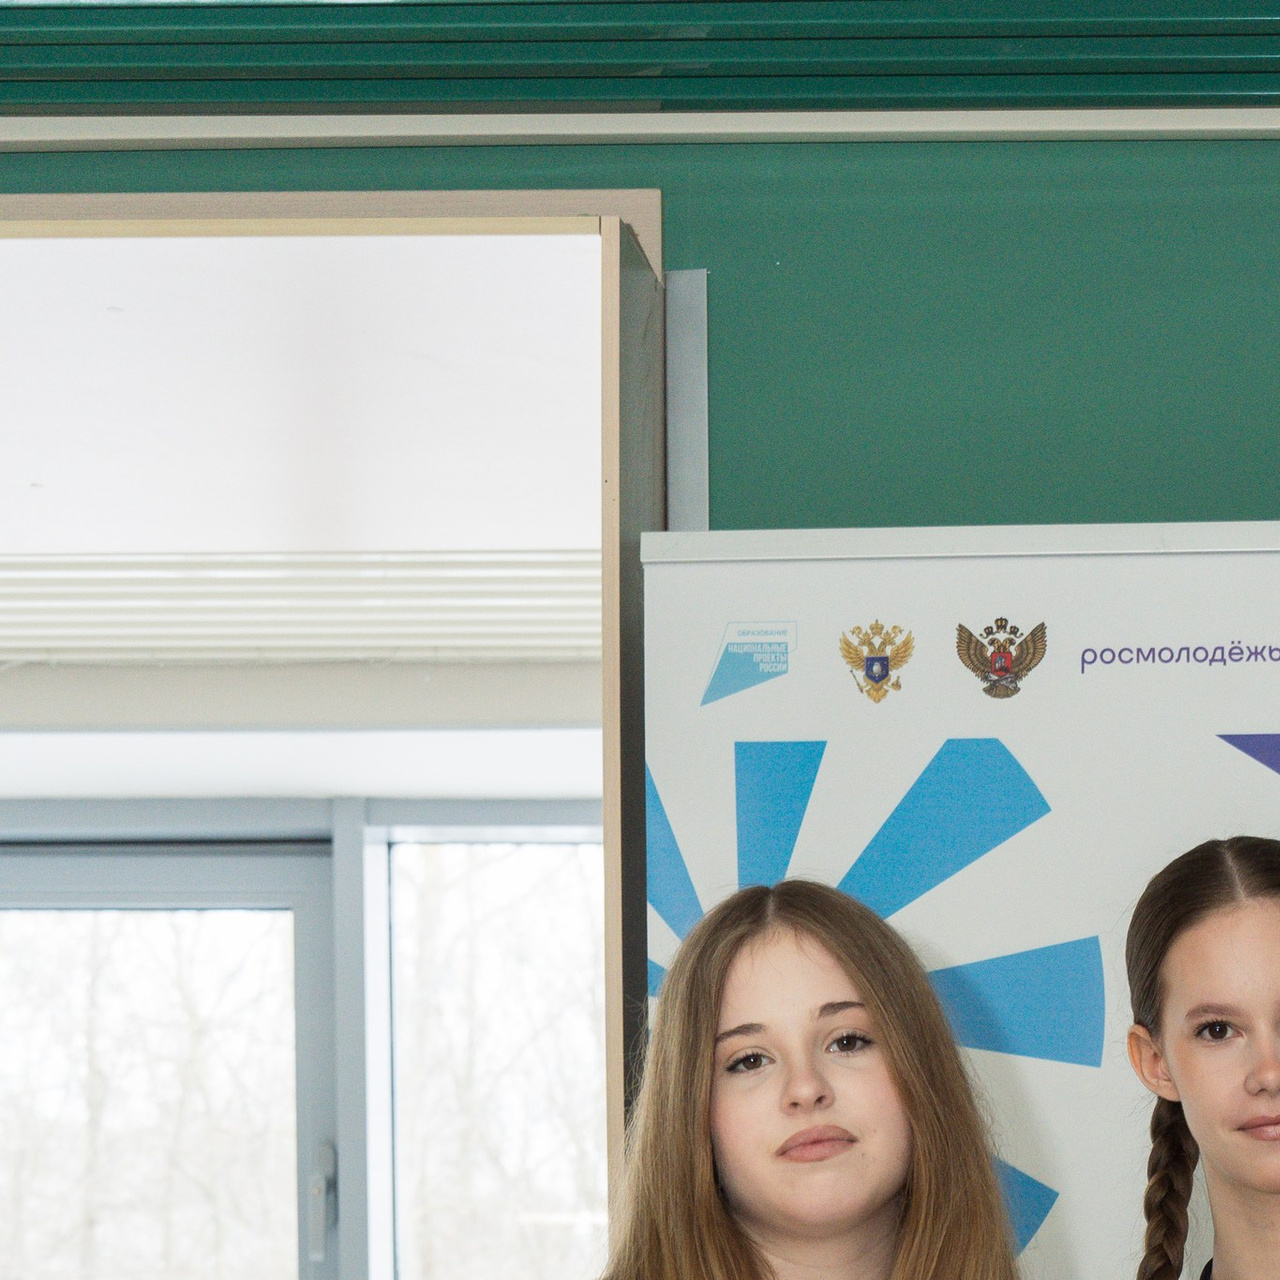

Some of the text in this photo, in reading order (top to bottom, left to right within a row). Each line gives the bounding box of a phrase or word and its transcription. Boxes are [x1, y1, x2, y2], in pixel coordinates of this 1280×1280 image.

[737, 629, 788, 637] ОБРАЗОВАНИЕ
[727, 643, 788, 653] НАЦИОНАЛЬНЫЕ
[753, 653, 787, 662] ПРОЕКТЫ
[759, 663, 787, 672] РОССИИ
